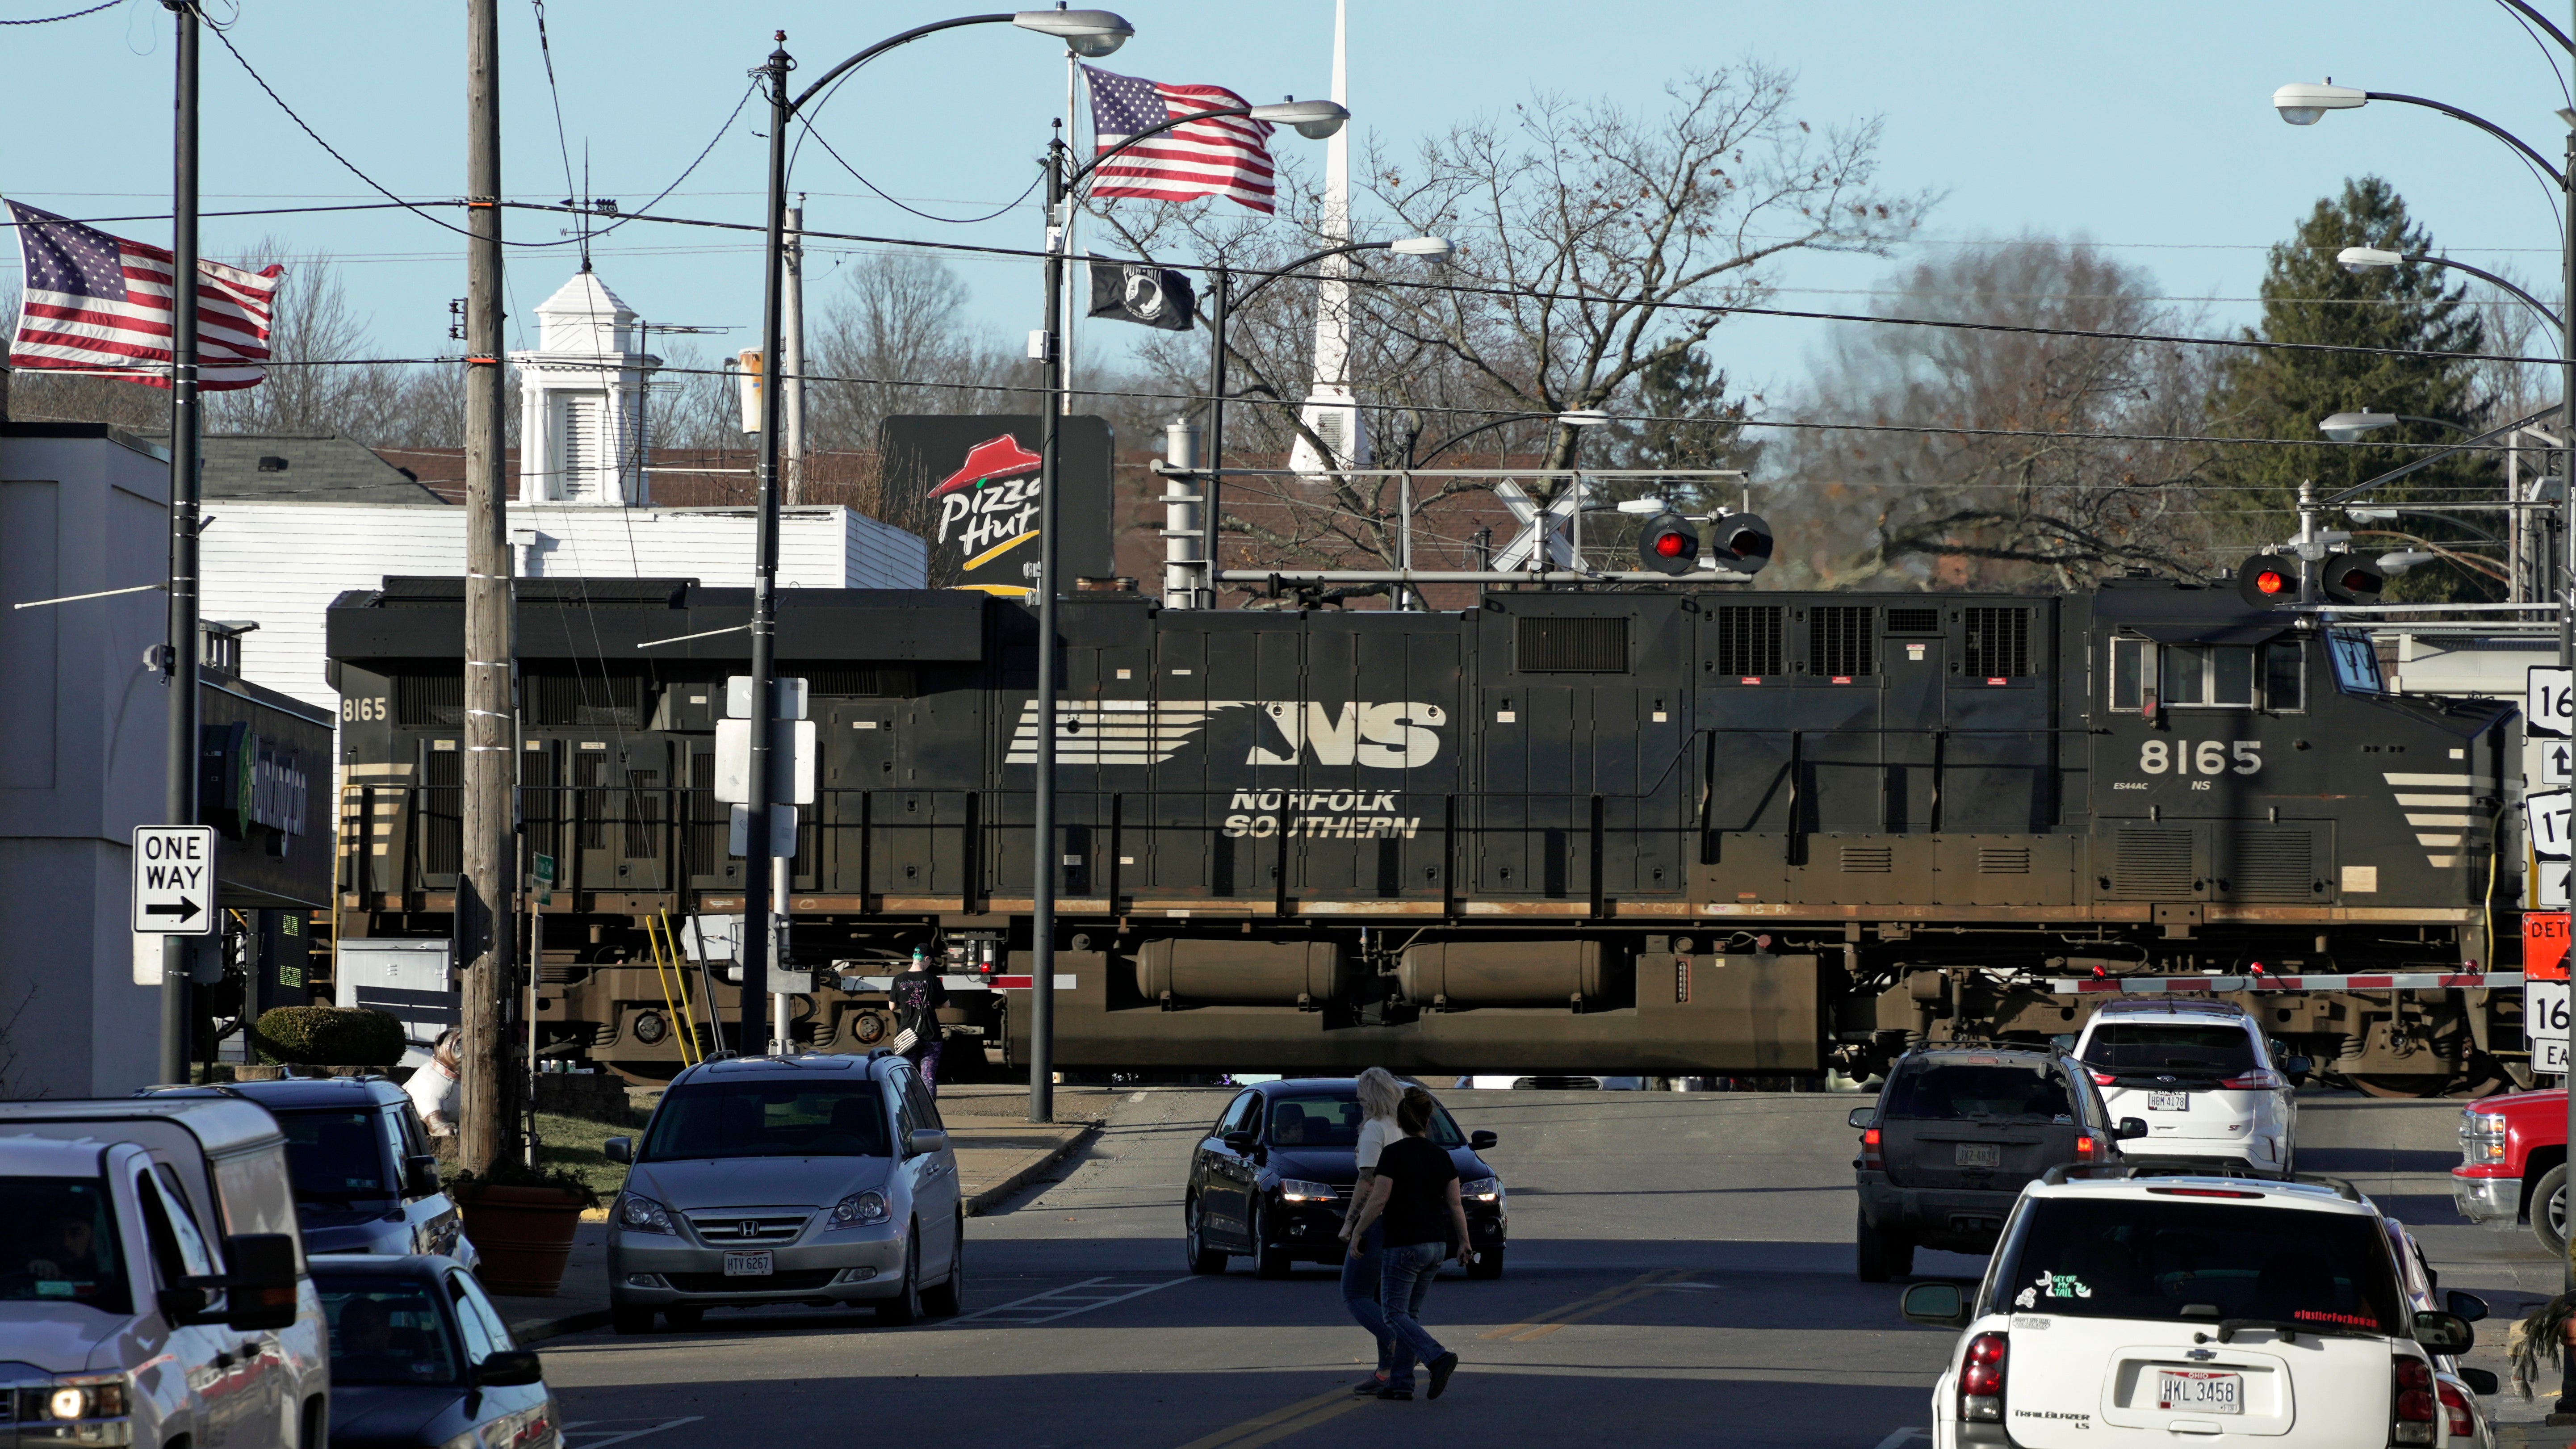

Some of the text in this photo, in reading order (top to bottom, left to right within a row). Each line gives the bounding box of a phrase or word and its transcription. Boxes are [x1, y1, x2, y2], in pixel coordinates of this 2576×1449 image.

[1123, 264, 1162, 286] POW MIA
[959, 503, 1039, 555] Hut
[343, 697, 386, 721] 8165
[2541, 686, 2572, 717] 16
[1246, 701, 1446, 768] NS
[2140, 740, 2262, 775] 8165
[248, 732, 307, 858] Huntington
[2191, 781, 2211, 790] NS
[1230, 788, 1401, 812] NORFOLK
[1222, 815, 1420, 839] SOUTHERN
[145, 836, 201, 860] ONE
[146, 866, 203, 889] WAY
[2532, 921, 2571, 938] DET
[2537, 998, 2570, 1030] 16
[2547, 1046, 2569, 1065] EA
[2151, 1096, 2184, 1106] HBM 4178
[728, 1257, 768, 1270] HTV 6267
[2055, 1288, 2073, 1298] TAIL
[2294, 1310, 2377, 1328] #JusticeForRowan
[2162, 1379, 2233, 1402] HKL 3458
